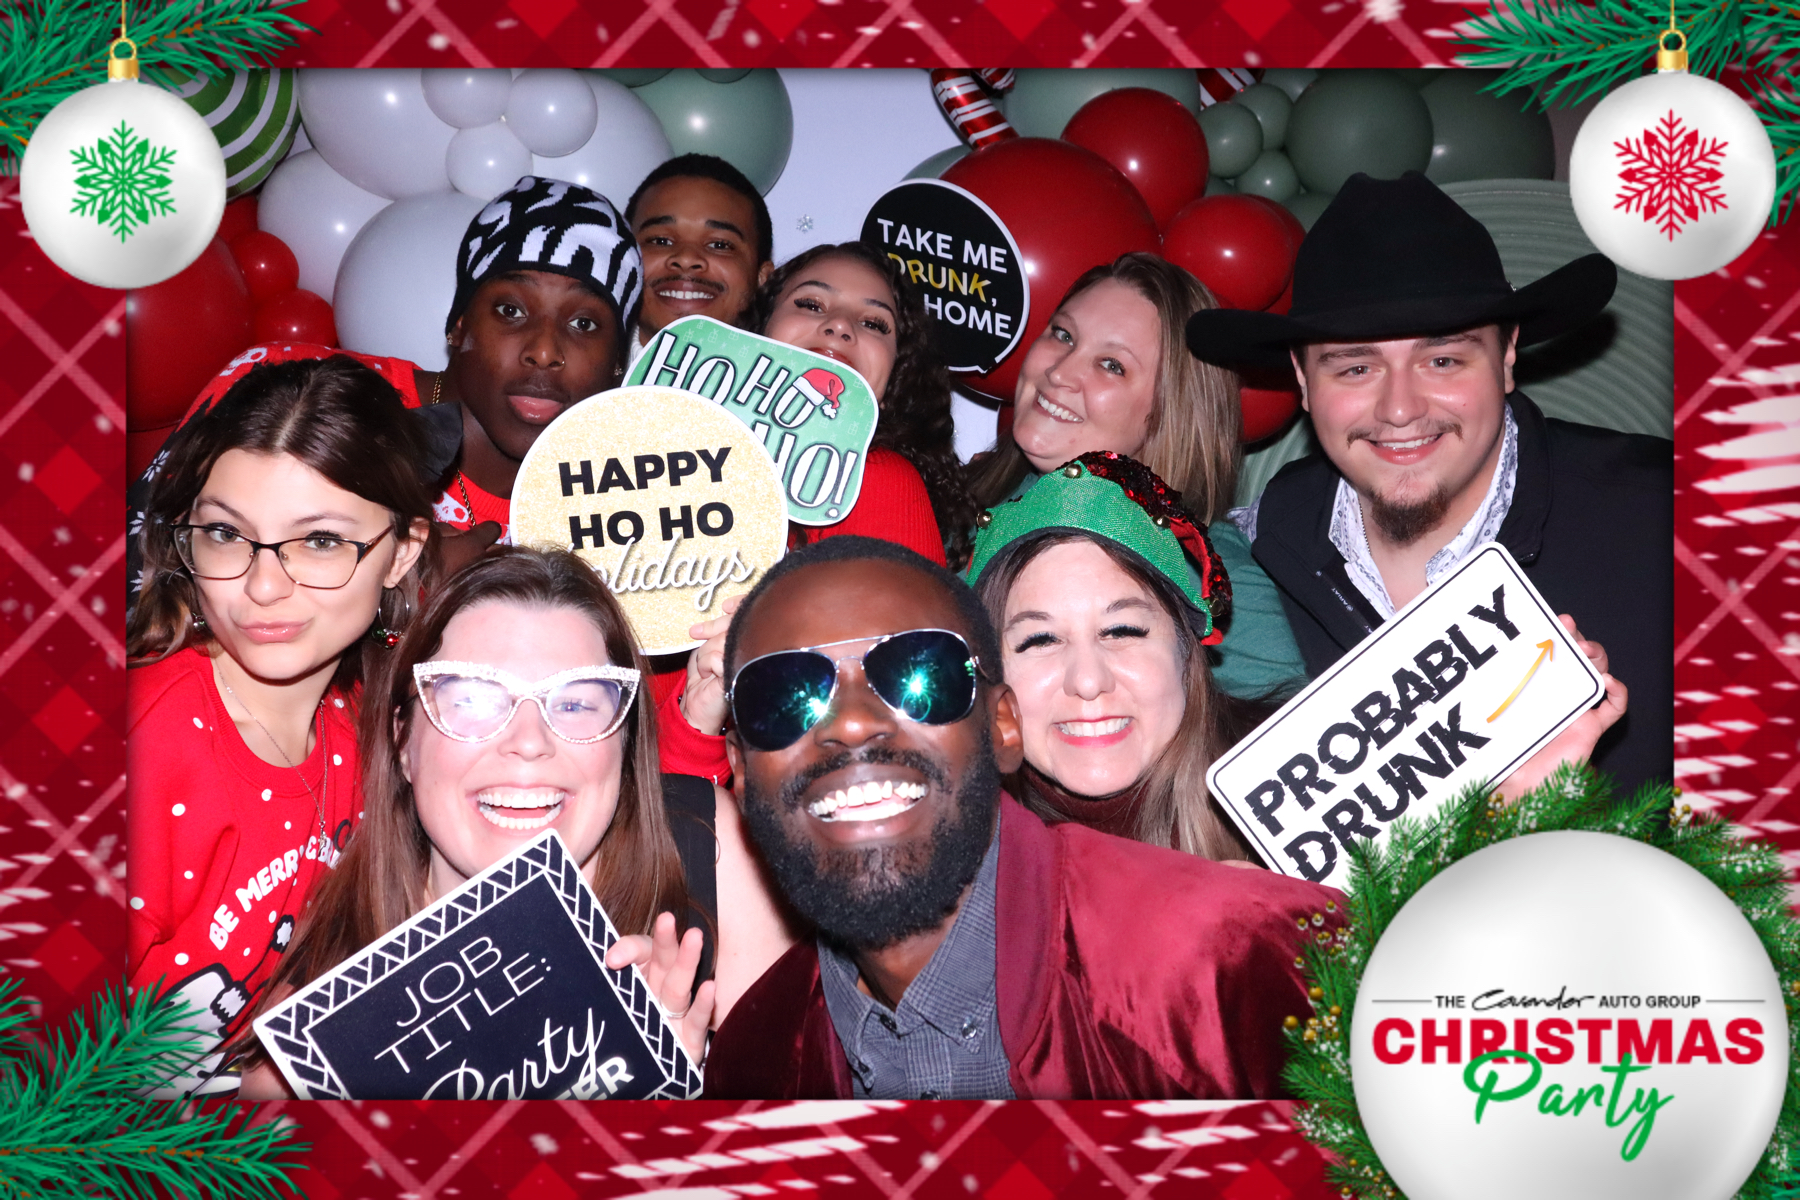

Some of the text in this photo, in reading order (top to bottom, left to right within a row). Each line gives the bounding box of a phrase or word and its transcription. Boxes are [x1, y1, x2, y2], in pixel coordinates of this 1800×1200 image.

[877, 218, 1008, 274] TAKE ME
[923, 293, 1012, 339] HOME
[734, 353, 817, 429] HO
[558, 446, 732, 497] HAPPY
[568, 502, 734, 550] HO HO
[568, 534, 755, 612] olidays
[1244, 583, 1521, 837] PROBABLY
[1283, 701, 1492, 883] DRUNK
[208, 903, 240, 951] BE
[374, 952, 552, 1074] TITLE:
[396, 935, 502, 1028] JOB
